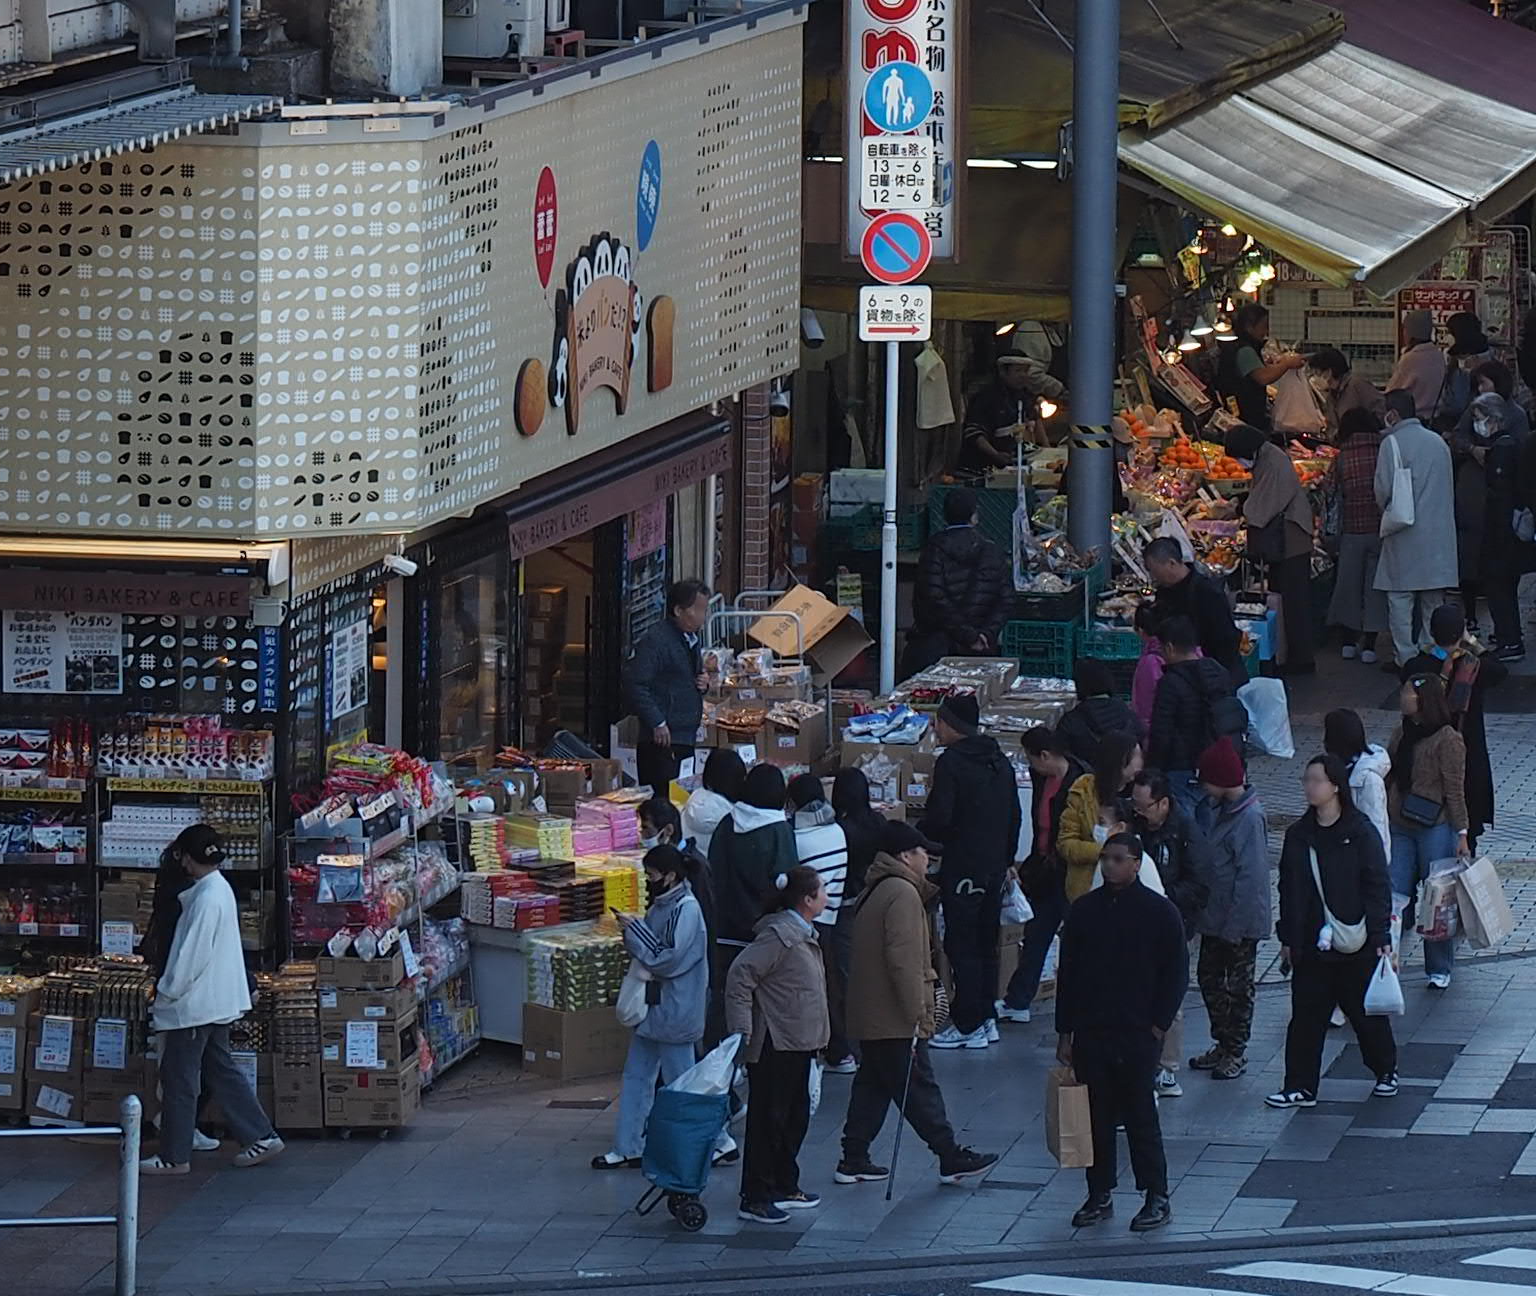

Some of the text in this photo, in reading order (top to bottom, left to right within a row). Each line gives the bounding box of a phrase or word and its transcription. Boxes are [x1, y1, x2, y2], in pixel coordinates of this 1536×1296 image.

[866, 143, 928, 159] 自転車を除く
[866, 308, 926, 323] 貨物を除く
[34, 585, 76, 602] NIKI
[83, 587, 161, 605] BAKERY
[190, 590, 240, 608] CAFE
